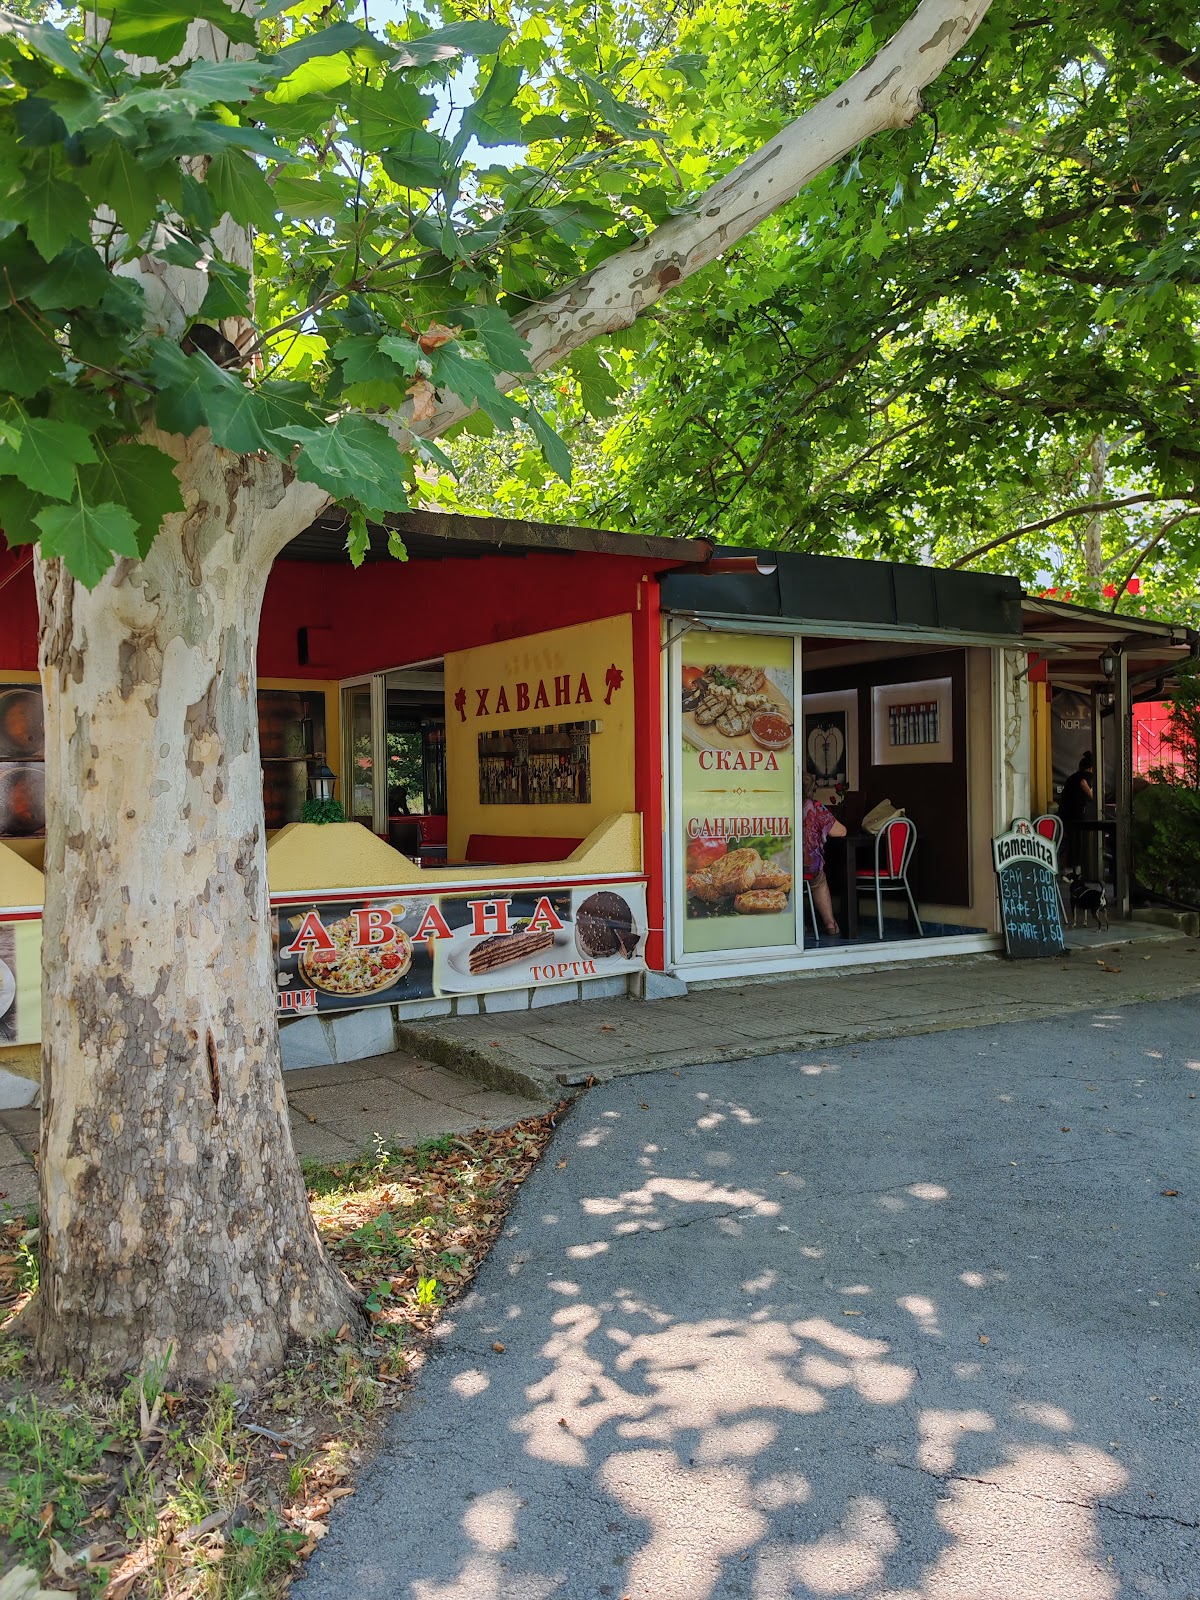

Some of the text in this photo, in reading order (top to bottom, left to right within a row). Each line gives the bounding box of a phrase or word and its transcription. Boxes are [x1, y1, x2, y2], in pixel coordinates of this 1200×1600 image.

[476, 673, 593, 716] ХАВАНА
[698, 750, 780, 771] СКАРА
[687, 817, 791, 843] САНДВИЧИ
[998, 836, 1053, 868] Kamenitza
[1003, 898, 1030, 917] КАФЕ
[287, 895, 564, 954] АВАНА
[530, 960, 597, 981] ТОРТИ
[277, 989, 318, 1013] ЦИ
